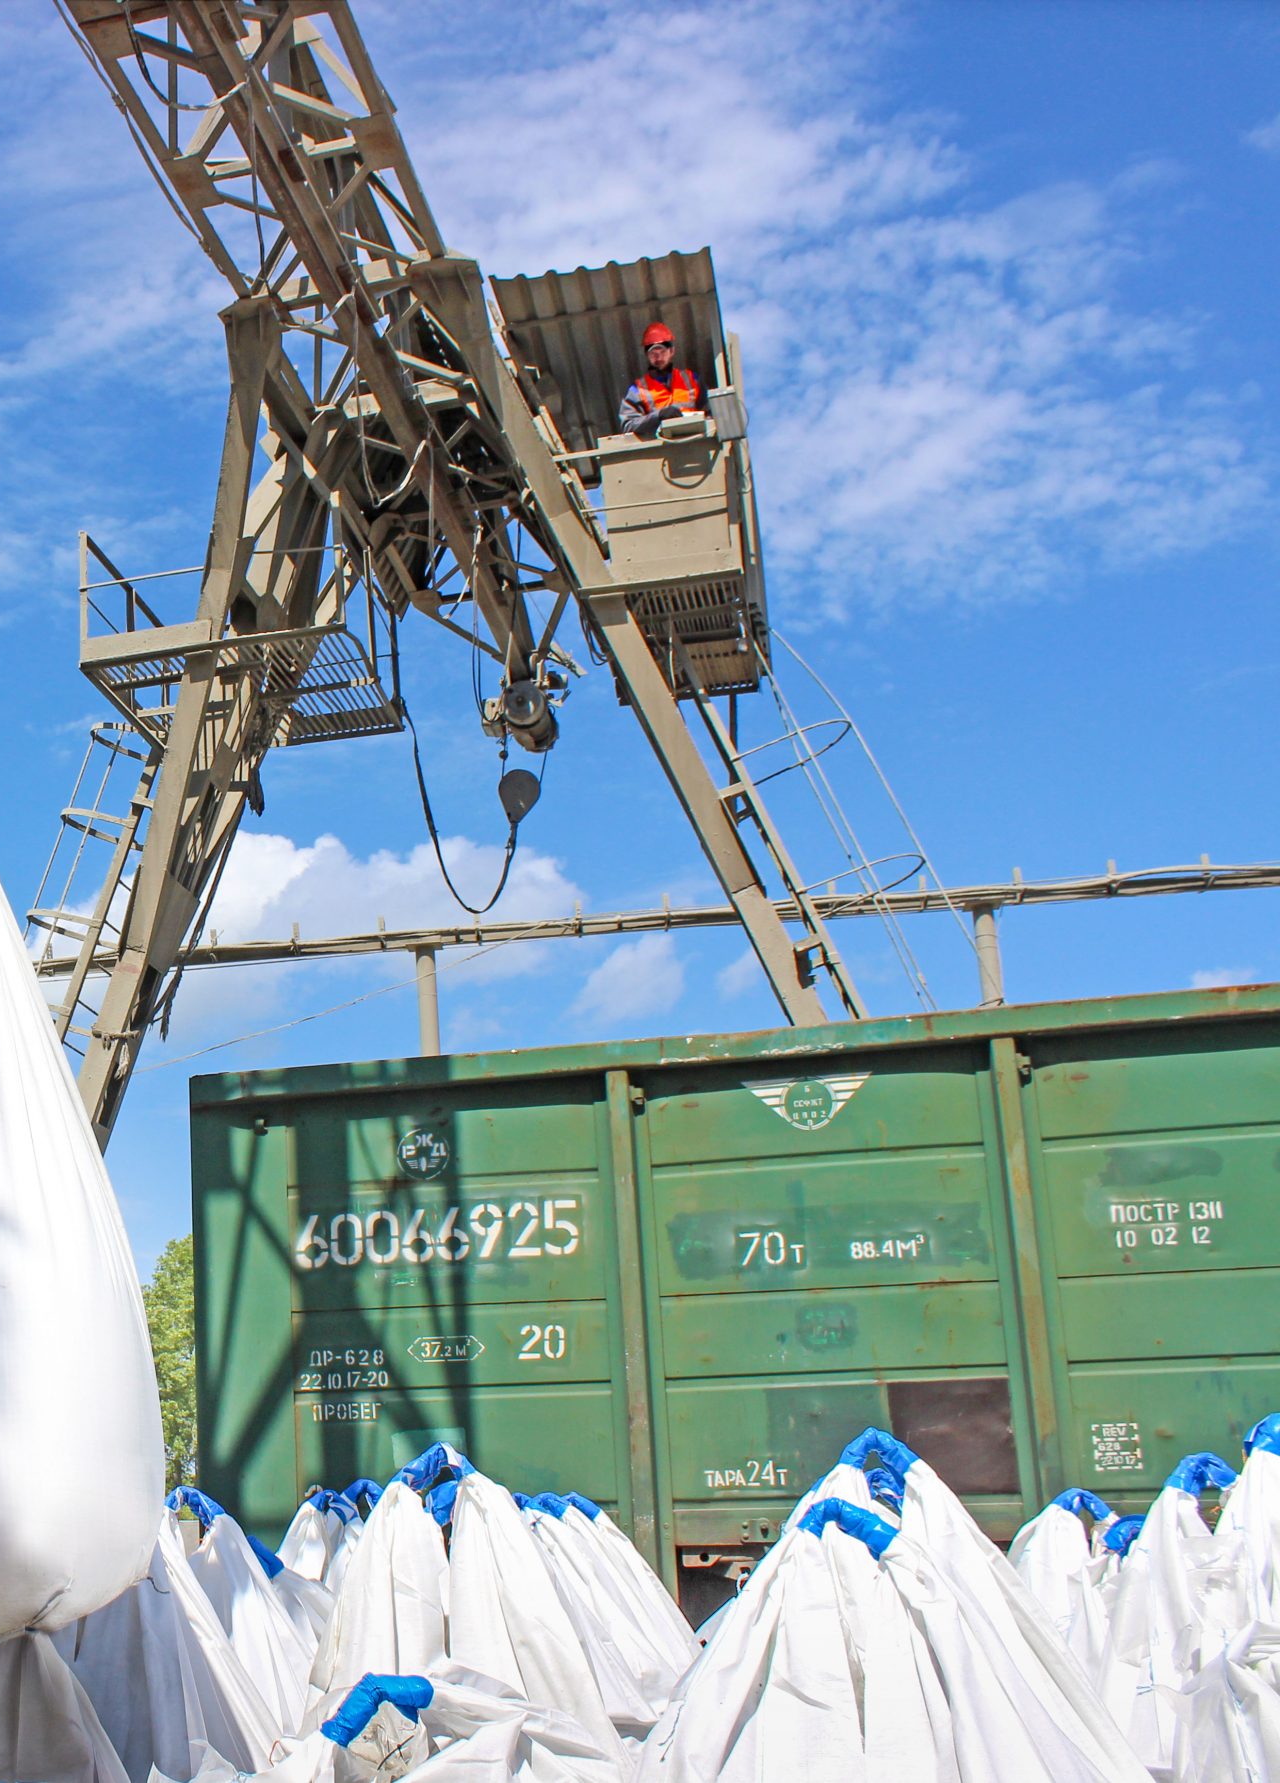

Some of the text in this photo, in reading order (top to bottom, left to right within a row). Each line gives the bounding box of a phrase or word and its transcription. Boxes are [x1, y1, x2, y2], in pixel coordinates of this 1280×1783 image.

[1110, 1201, 1223, 1223] ПОСТР 1311
[296, 1200, 579, 1268] 60066925
[518, 1324, 565, 1360] 20
[300, 1370, 388, 1390] 22.10.17-20
[312, 1402, 382, 1422] ПРОБЕГ
[1102, 1427, 1126, 1437] REV
[1098, 1442, 1120, 1451] 628
